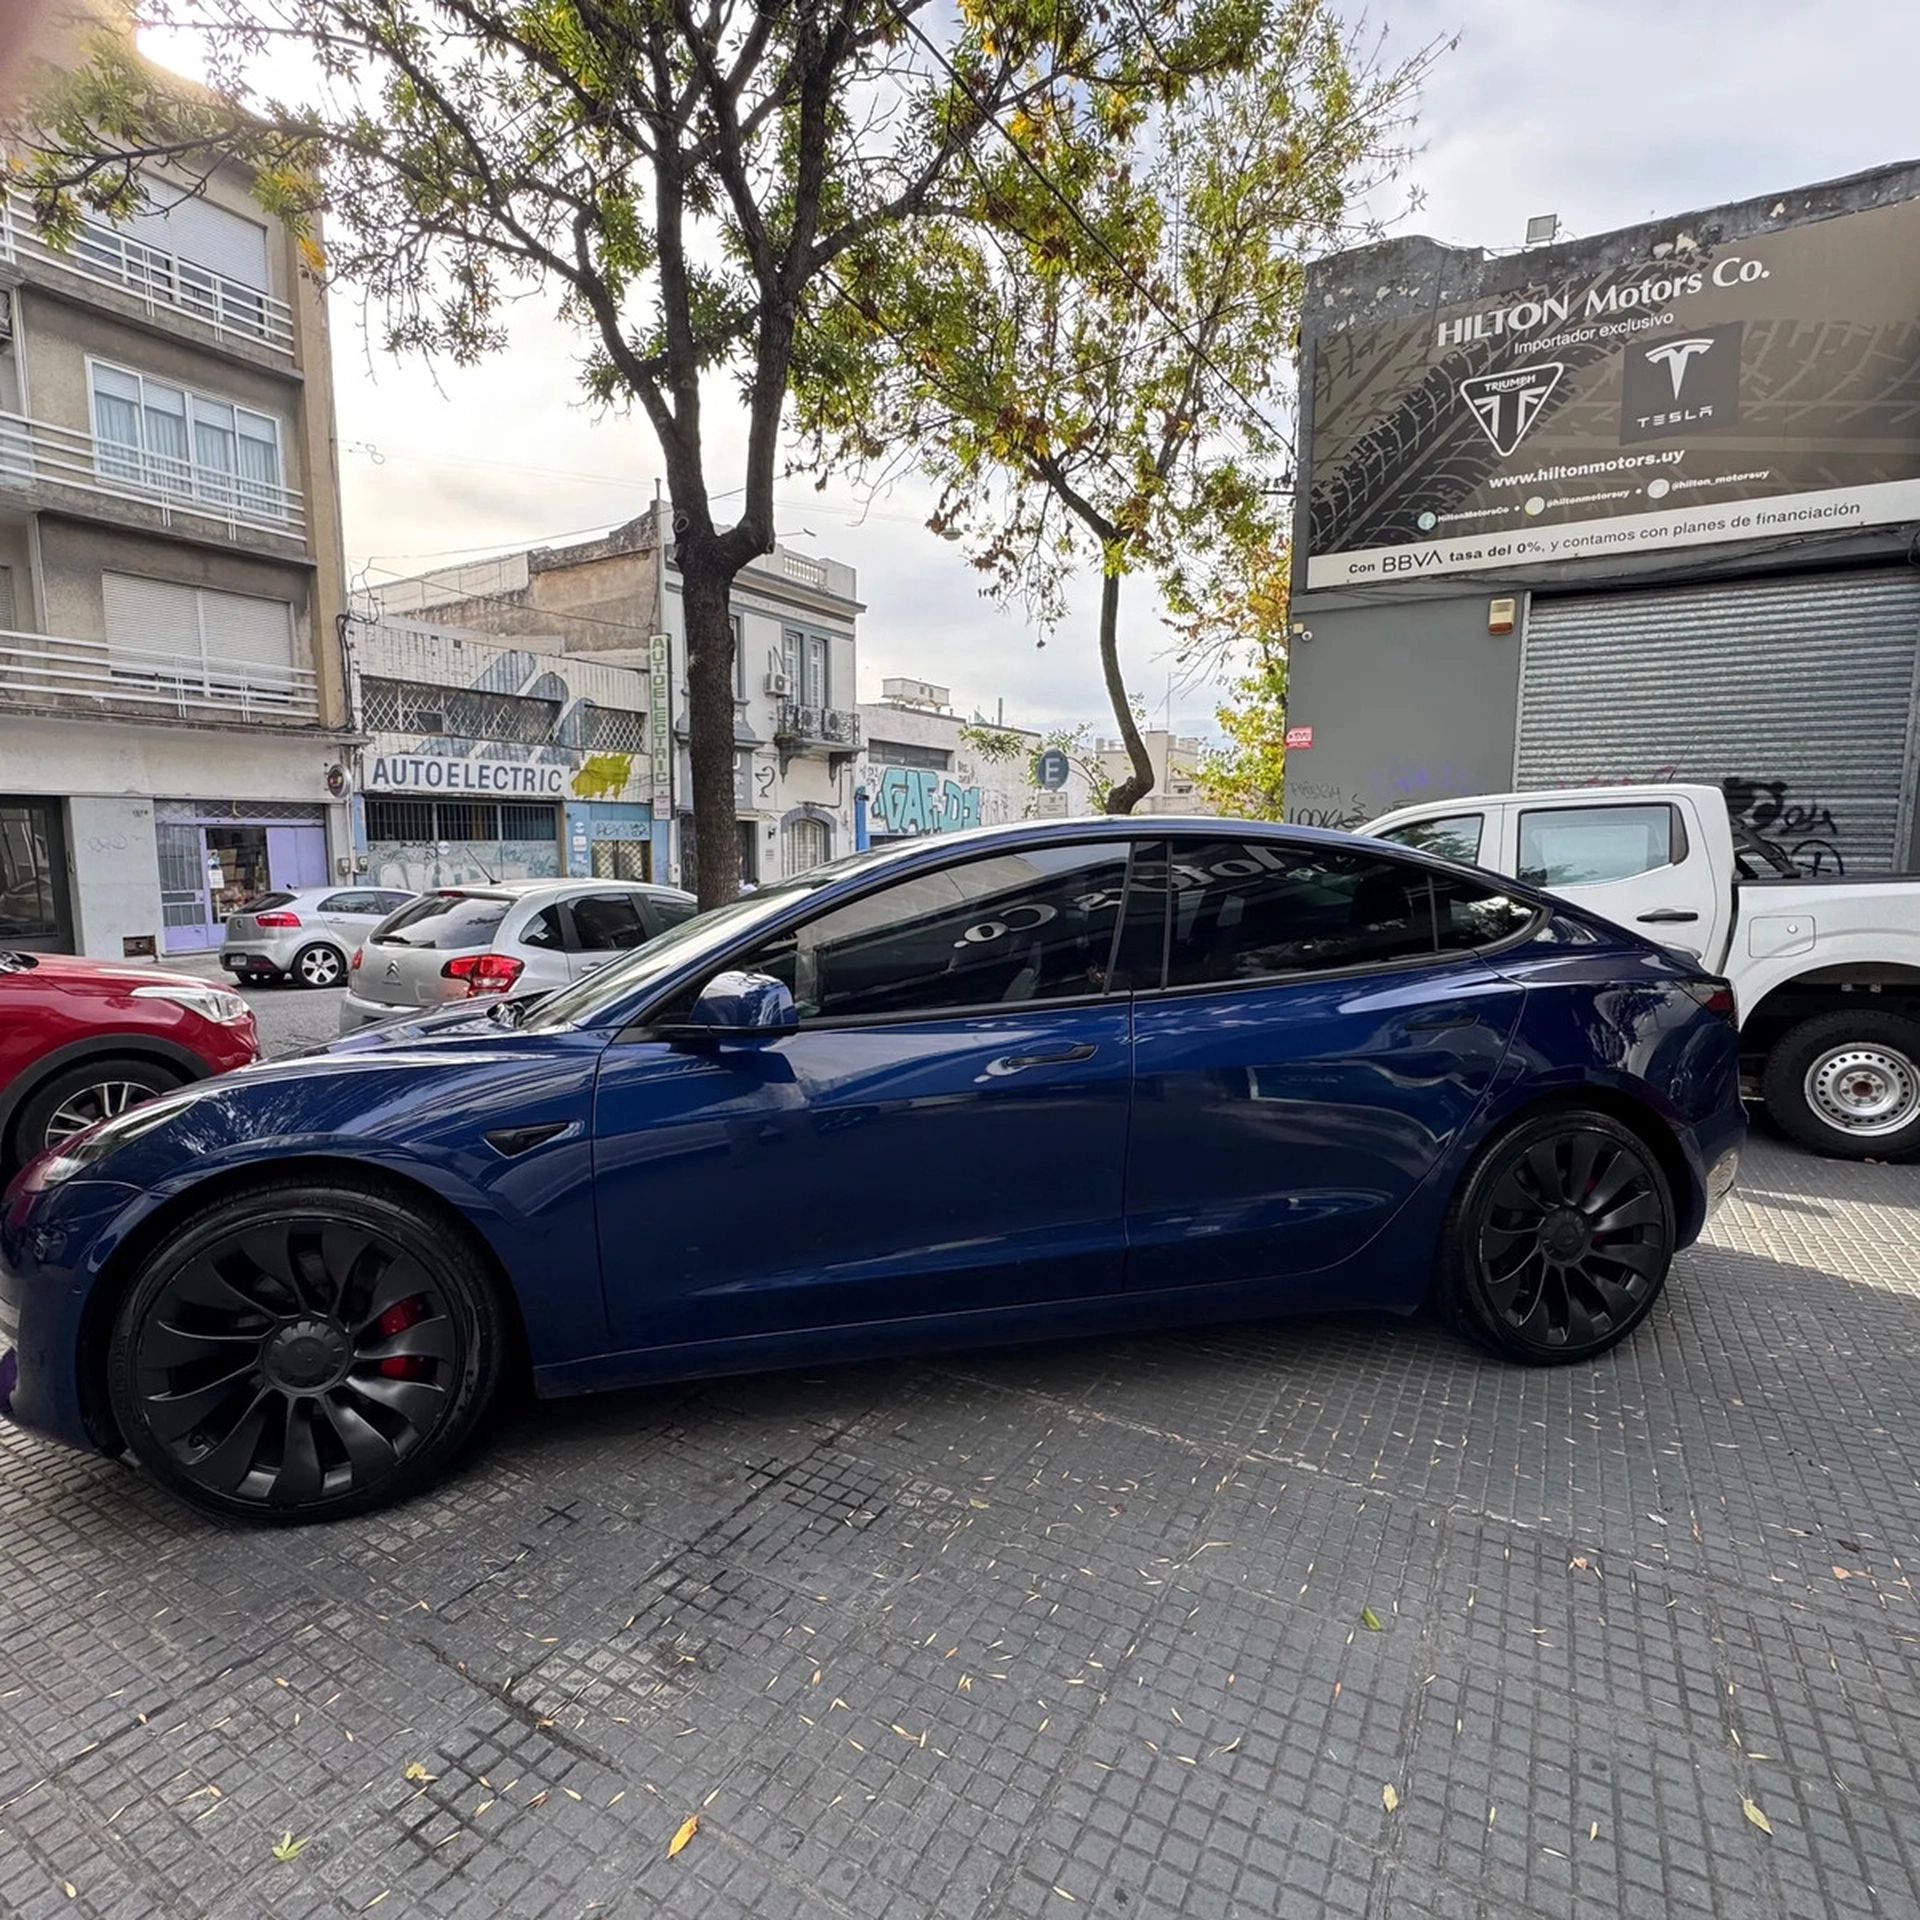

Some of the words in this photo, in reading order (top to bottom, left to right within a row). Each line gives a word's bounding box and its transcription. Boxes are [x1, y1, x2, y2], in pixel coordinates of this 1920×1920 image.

[1438, 295, 1568, 347] HILTON
[1584, 273, 1702, 317] Motors
[1712, 257, 1770, 287] Co.
[1514, 328, 1595, 355] Importador
[1600, 312, 1674, 337] exclusivo
[1484, 374, 1536, 392] TRIUMPH
[1637, 405, 1713, 428] TESLA
[1488, 450, 1685, 489] www.hiltonmotors.uy
[1349, 563, 1376, 574] Con
[1382, 550, 1443, 573] BBVA
[1449, 550, 1482, 562] tasa
[1488, 544, 1511, 558] del
[1550, 540, 1559, 552] y
[1563, 530, 1635, 549] contamos
[1640, 526, 1668, 539] con
[1672, 519, 1726, 537] planes
[1731, 515, 1751, 528] de
[1756, 501, 1861, 525] financiación
[652, 637, 667, 783] AUTOELECTRIC
[371, 758, 563, 793] AUTOELECTRIC
[1045, 757, 1060, 782] E
